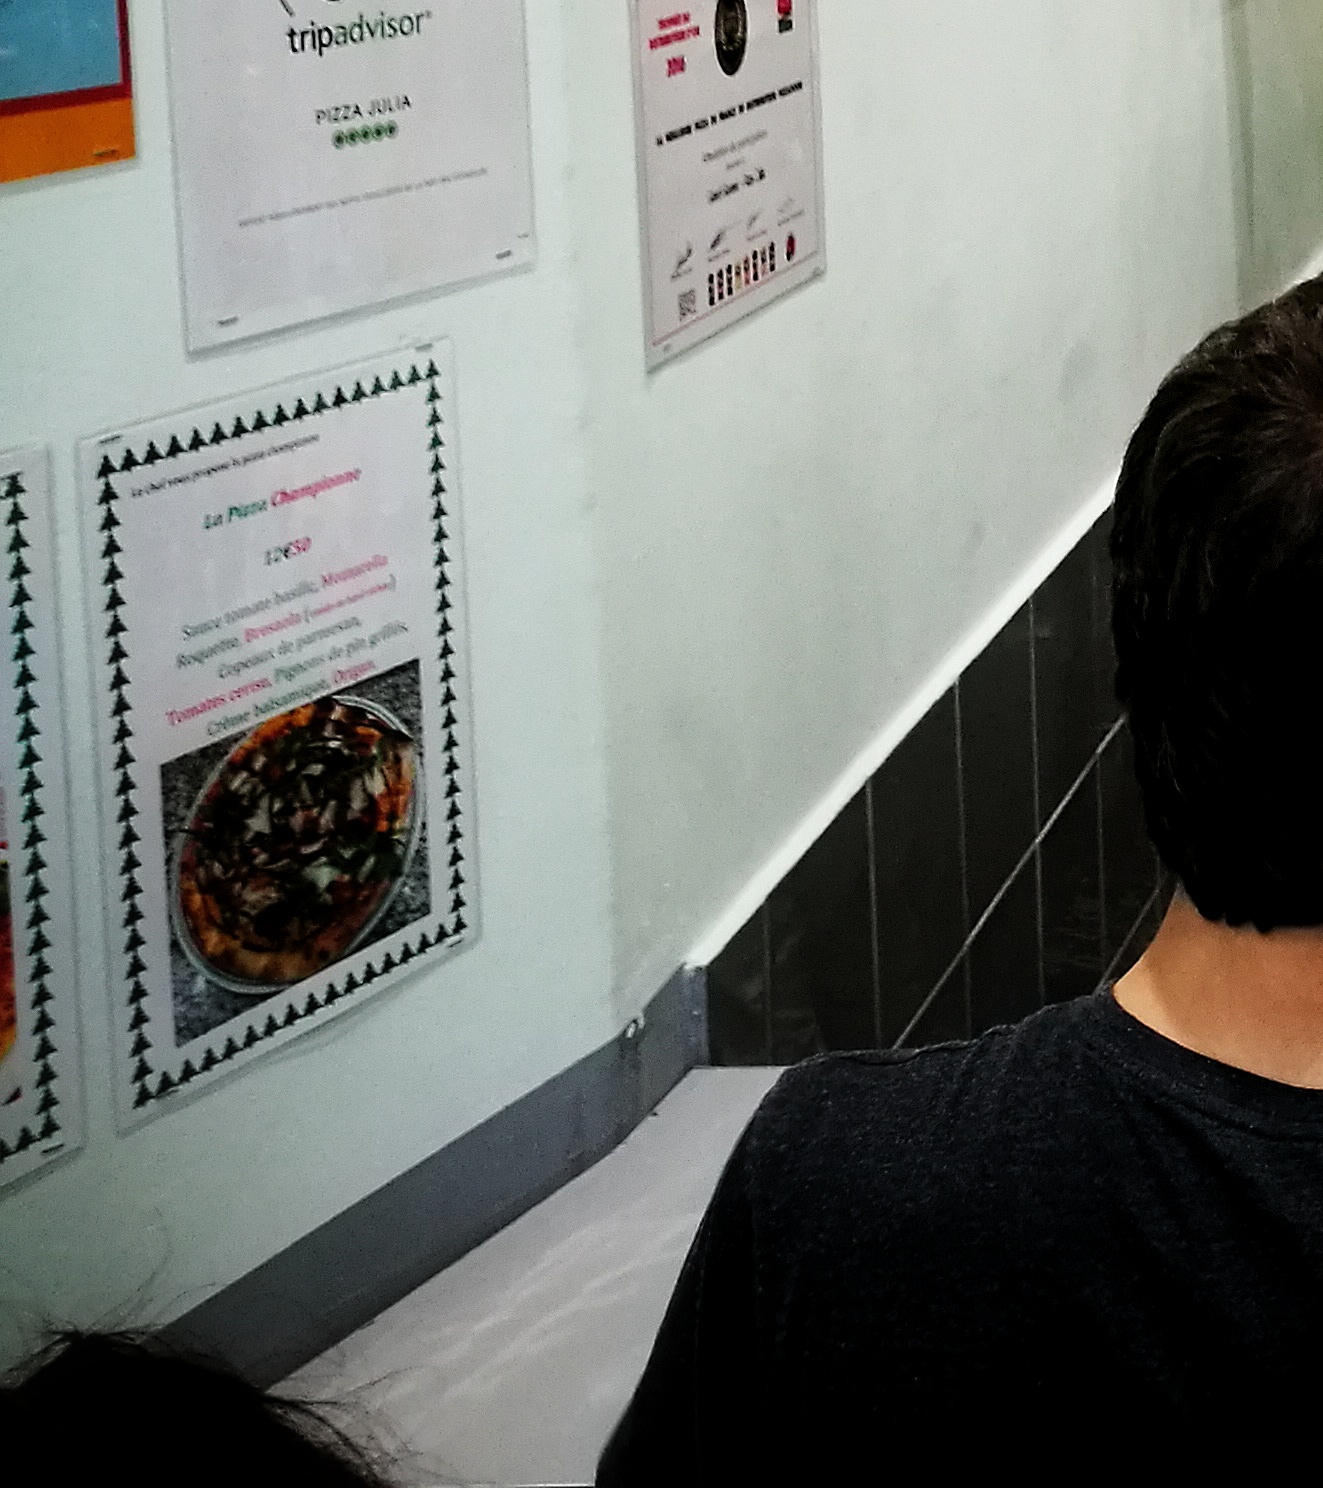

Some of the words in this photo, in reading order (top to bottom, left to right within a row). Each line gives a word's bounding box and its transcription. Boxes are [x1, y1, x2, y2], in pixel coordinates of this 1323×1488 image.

[286, 12, 424, 57] tripadvisor
[316, 105, 363, 126] PIZZA
[368, 94, 412, 120] JULIA
